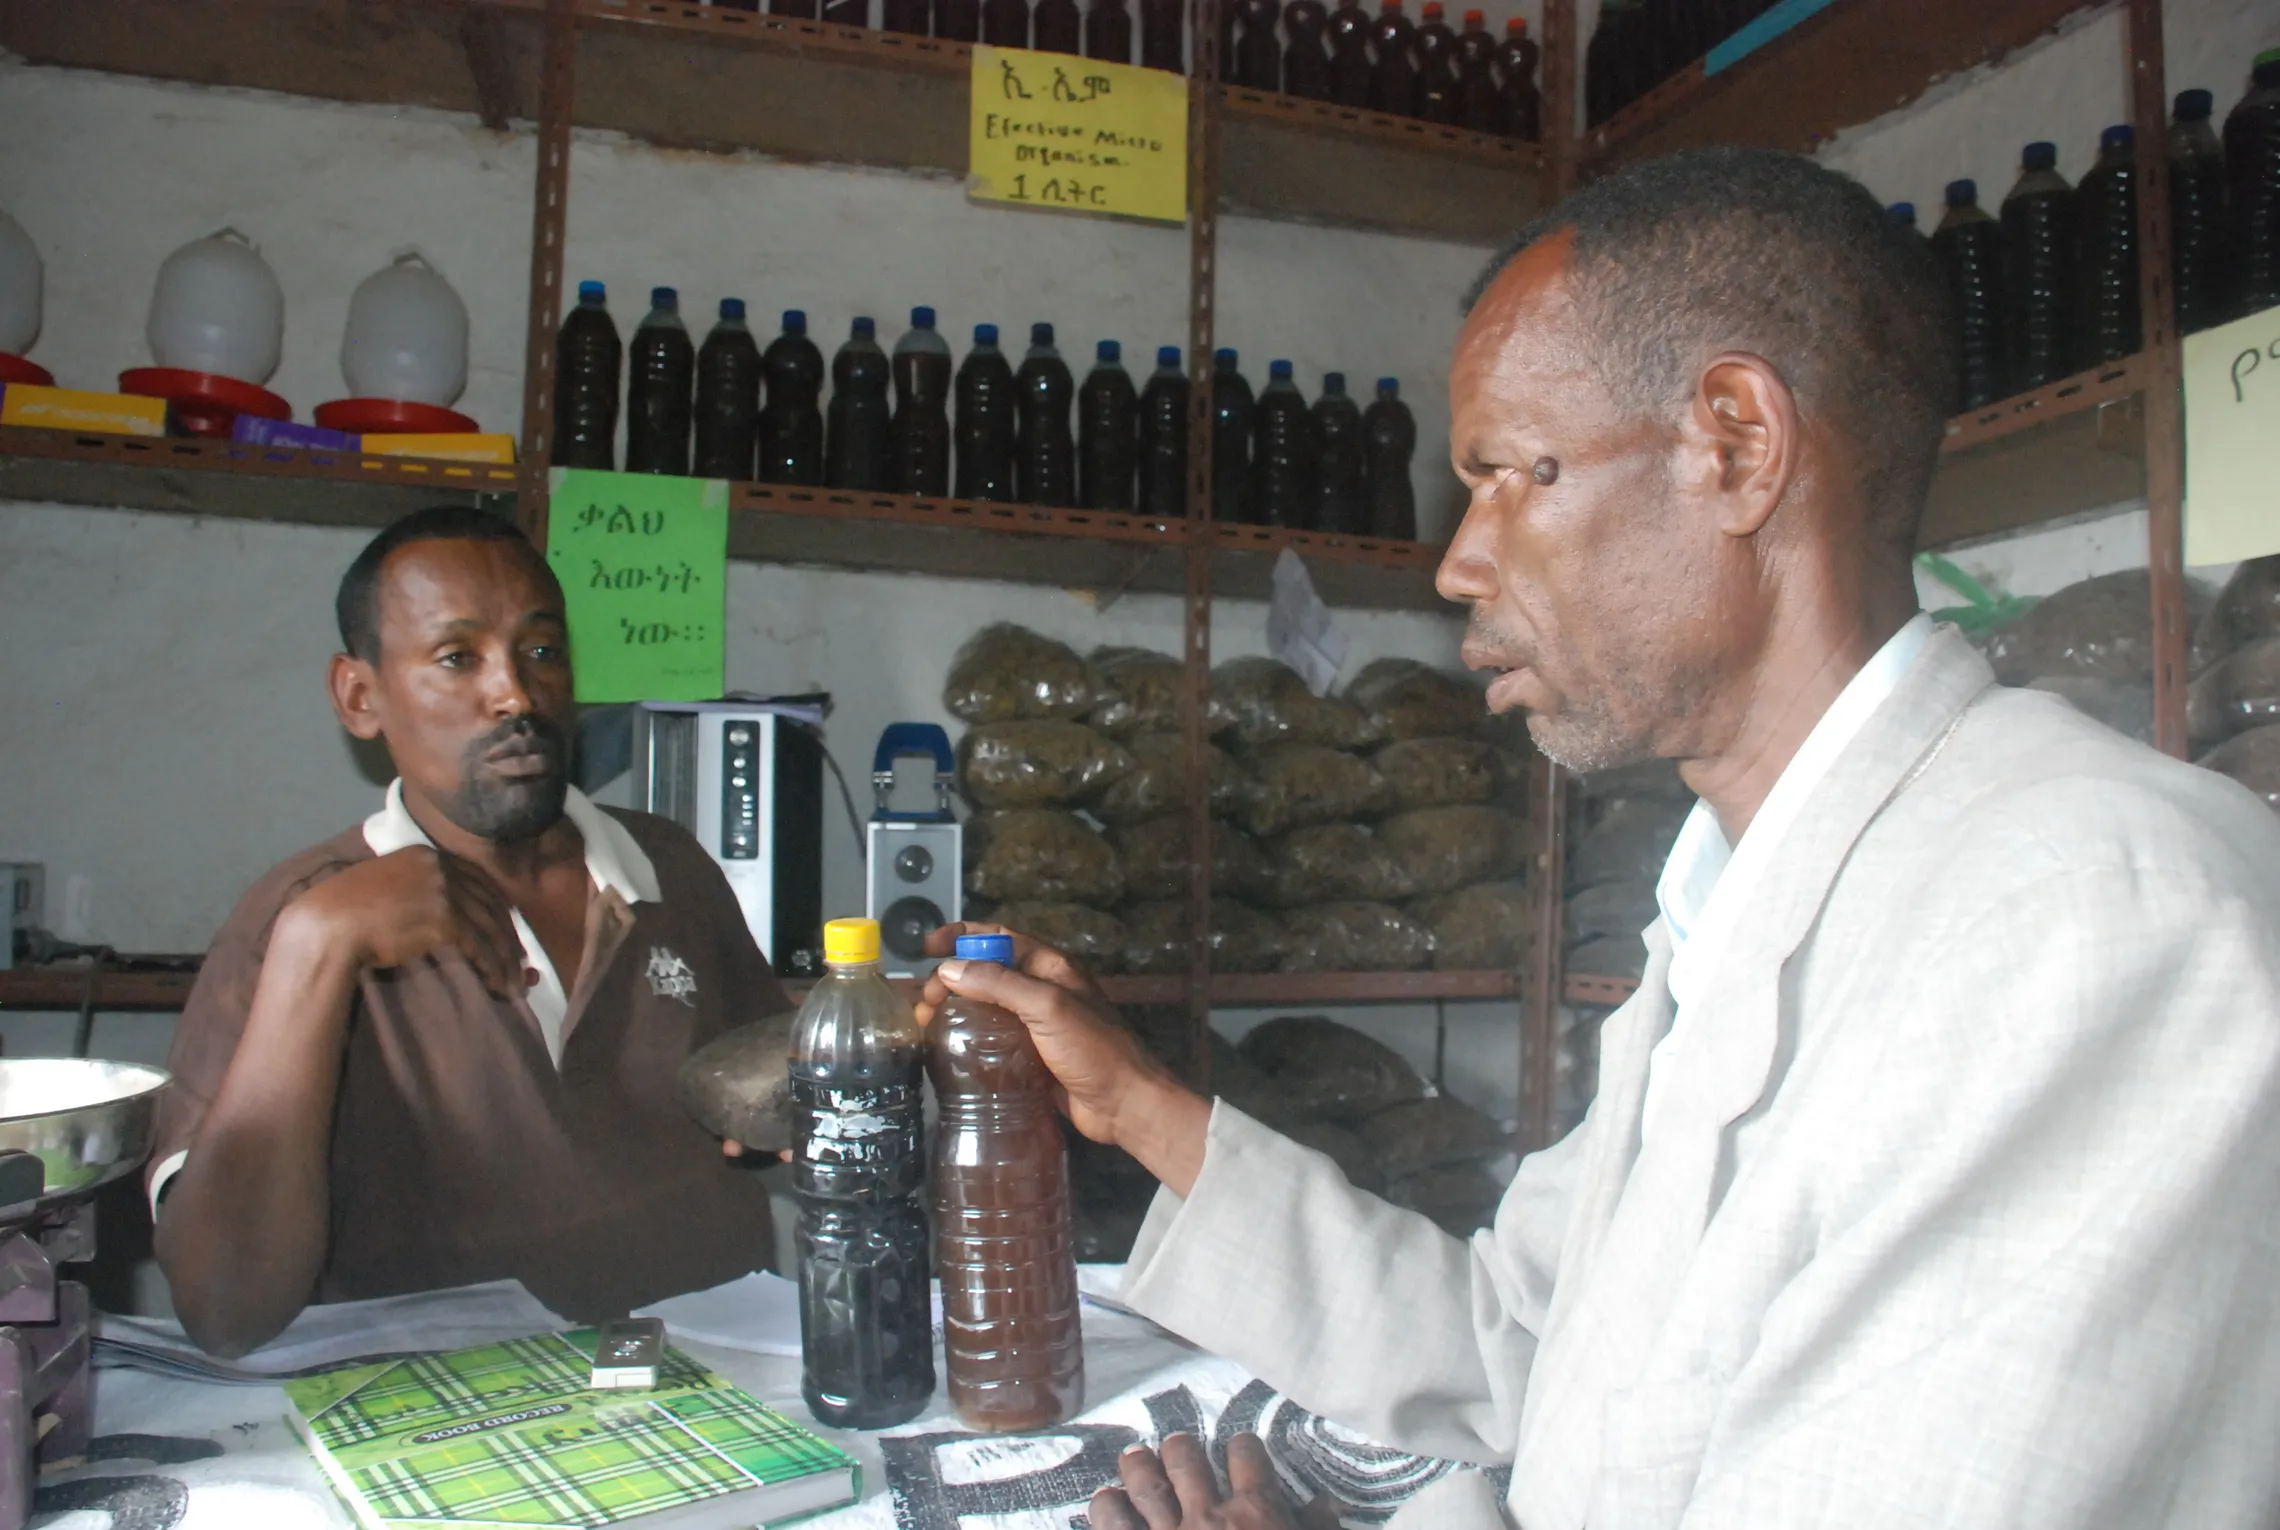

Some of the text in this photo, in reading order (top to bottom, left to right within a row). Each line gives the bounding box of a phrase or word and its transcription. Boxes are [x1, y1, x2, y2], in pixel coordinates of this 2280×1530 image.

[1008, 173, 1031, 199] 1
[422, 1404, 565, 1442] RECORD BOOK
